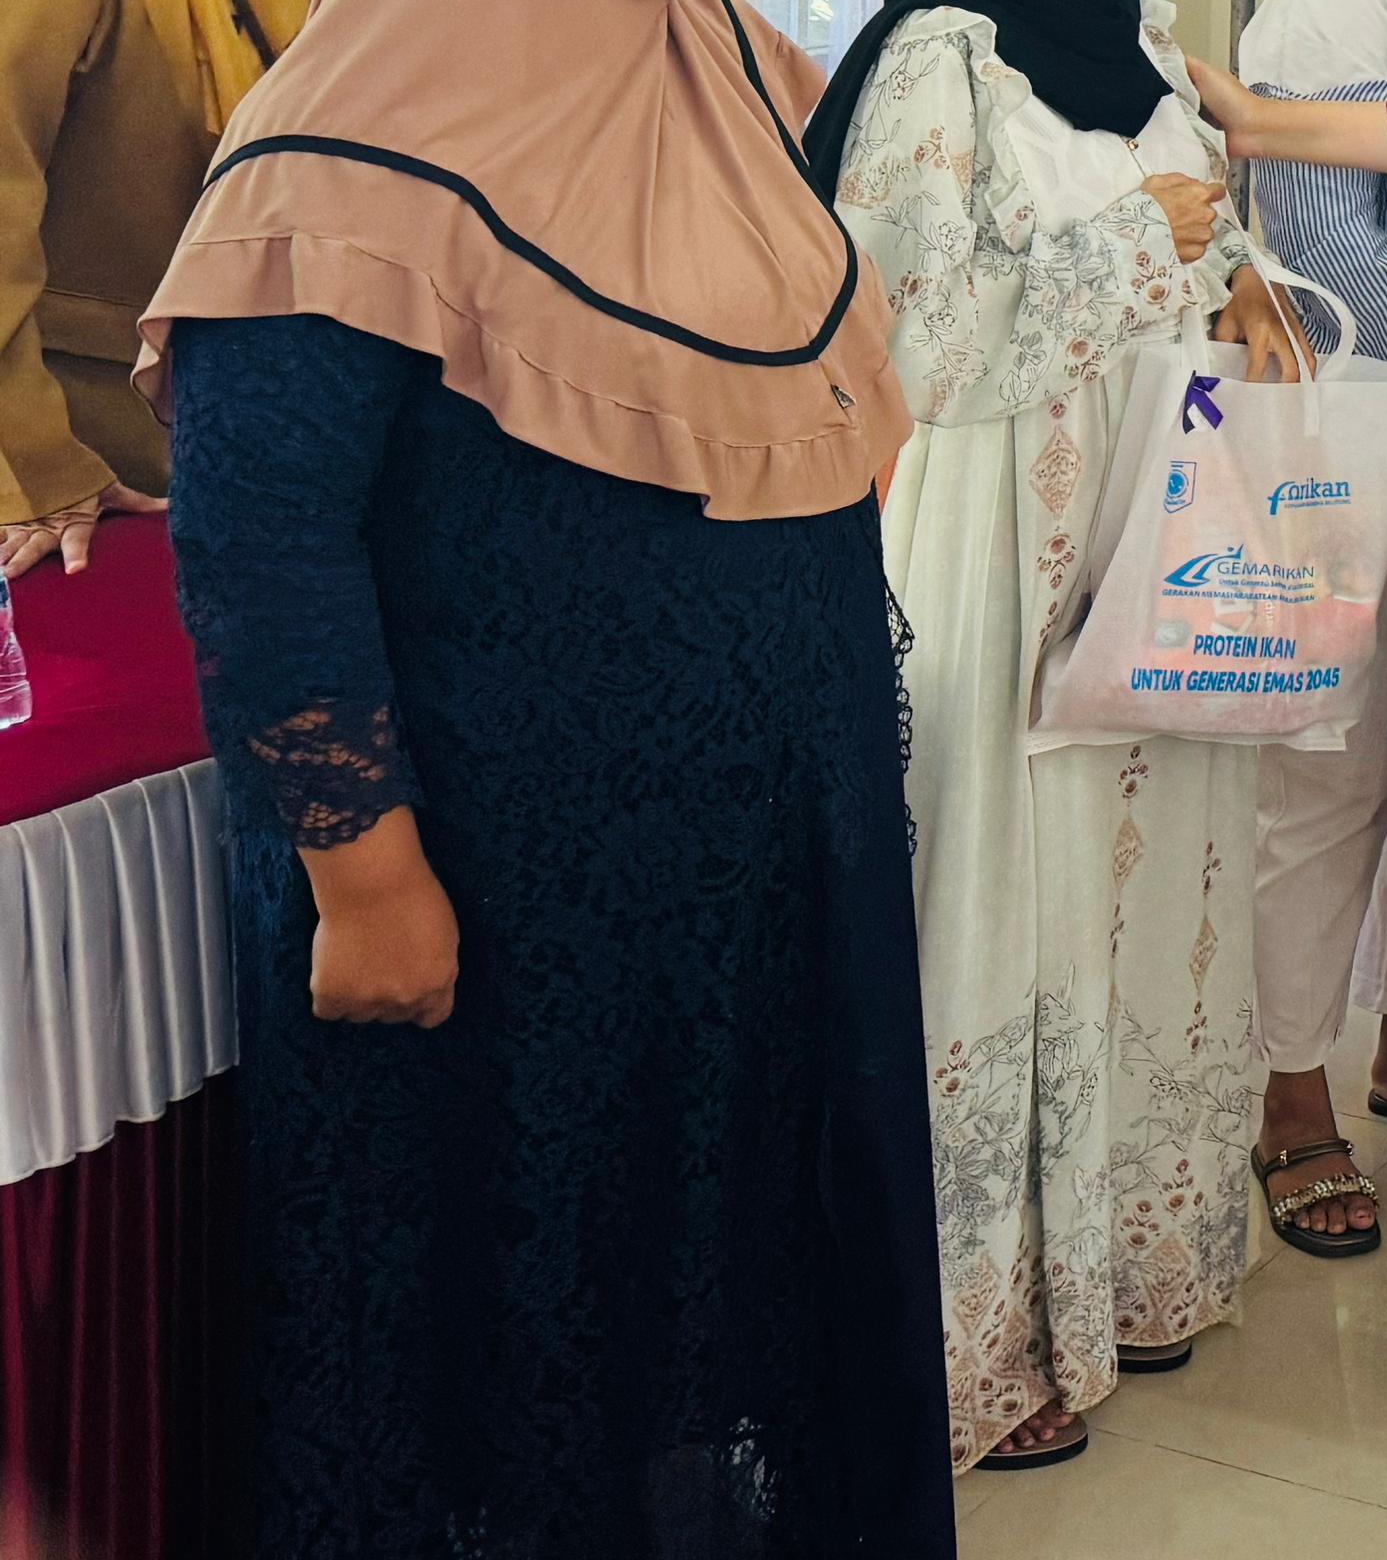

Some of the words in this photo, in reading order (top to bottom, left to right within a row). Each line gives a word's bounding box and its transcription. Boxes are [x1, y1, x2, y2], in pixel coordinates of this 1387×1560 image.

[1216, 561, 1315, 581] GEMARIKAN
[1193, 634, 1258, 658] PROTEIN
[1259, 636, 1296, 660] IKAN
[1131, 668, 1184, 691] UNTUK
[1186, 670, 1260, 693] GENERASI
[1262, 671, 1304, 694] EMAS
[1305, 667, 1340, 691] 2045
